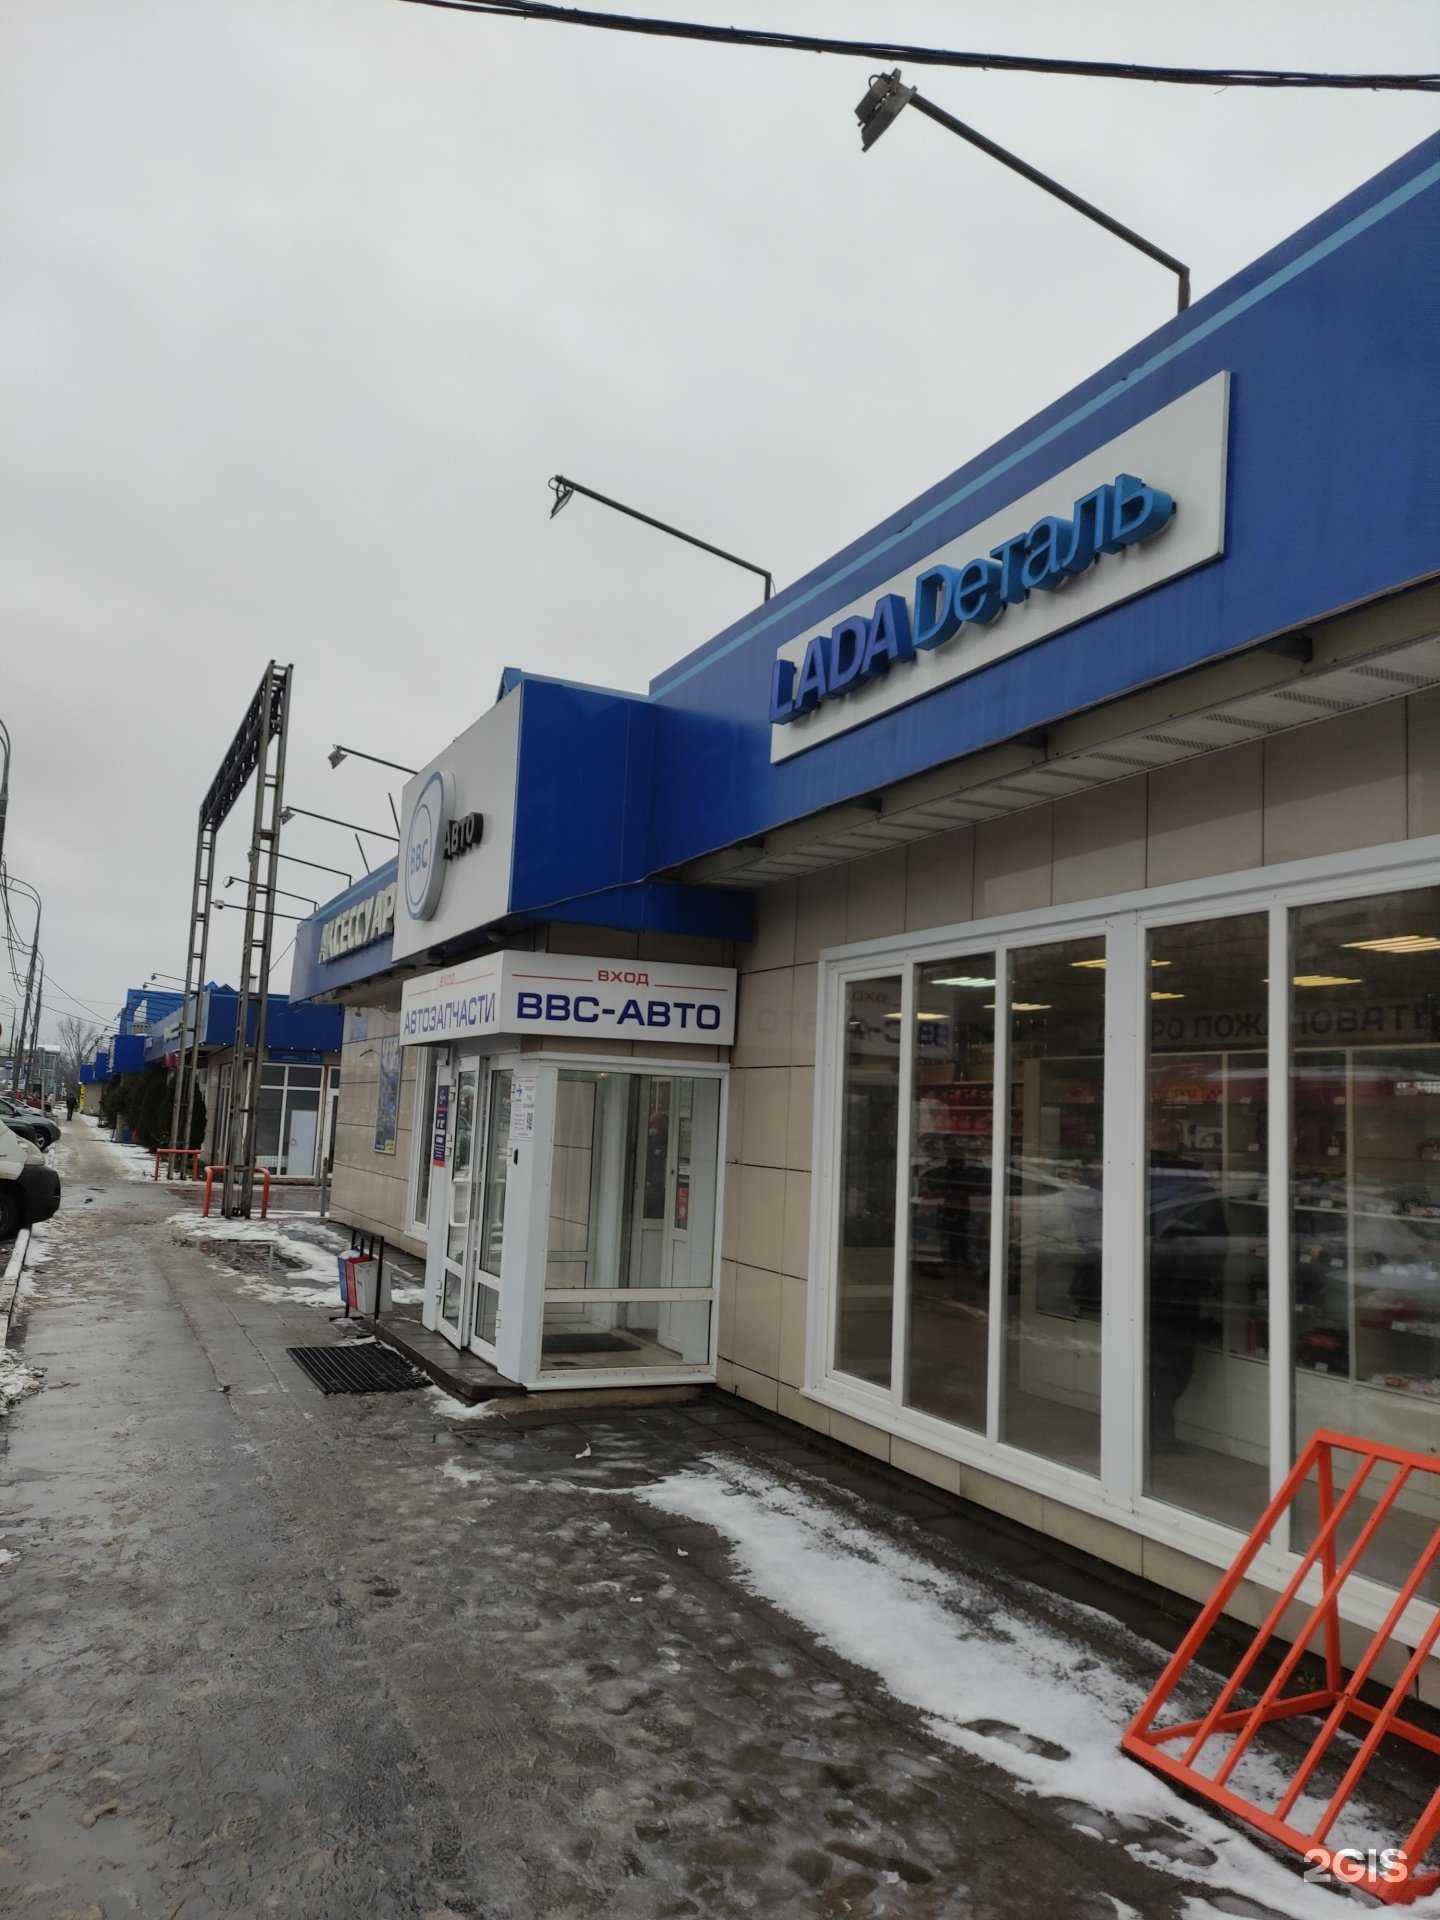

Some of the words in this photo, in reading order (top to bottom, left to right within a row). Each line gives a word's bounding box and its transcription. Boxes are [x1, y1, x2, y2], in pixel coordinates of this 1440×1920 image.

[770, 593, 914, 725] LADA
[598, 970, 649, 986] ВХОД
[403, 992, 496, 1035] АВТОЗАПЧАСТИ
[516, 992, 721, 1030] ВВС-АВТО
